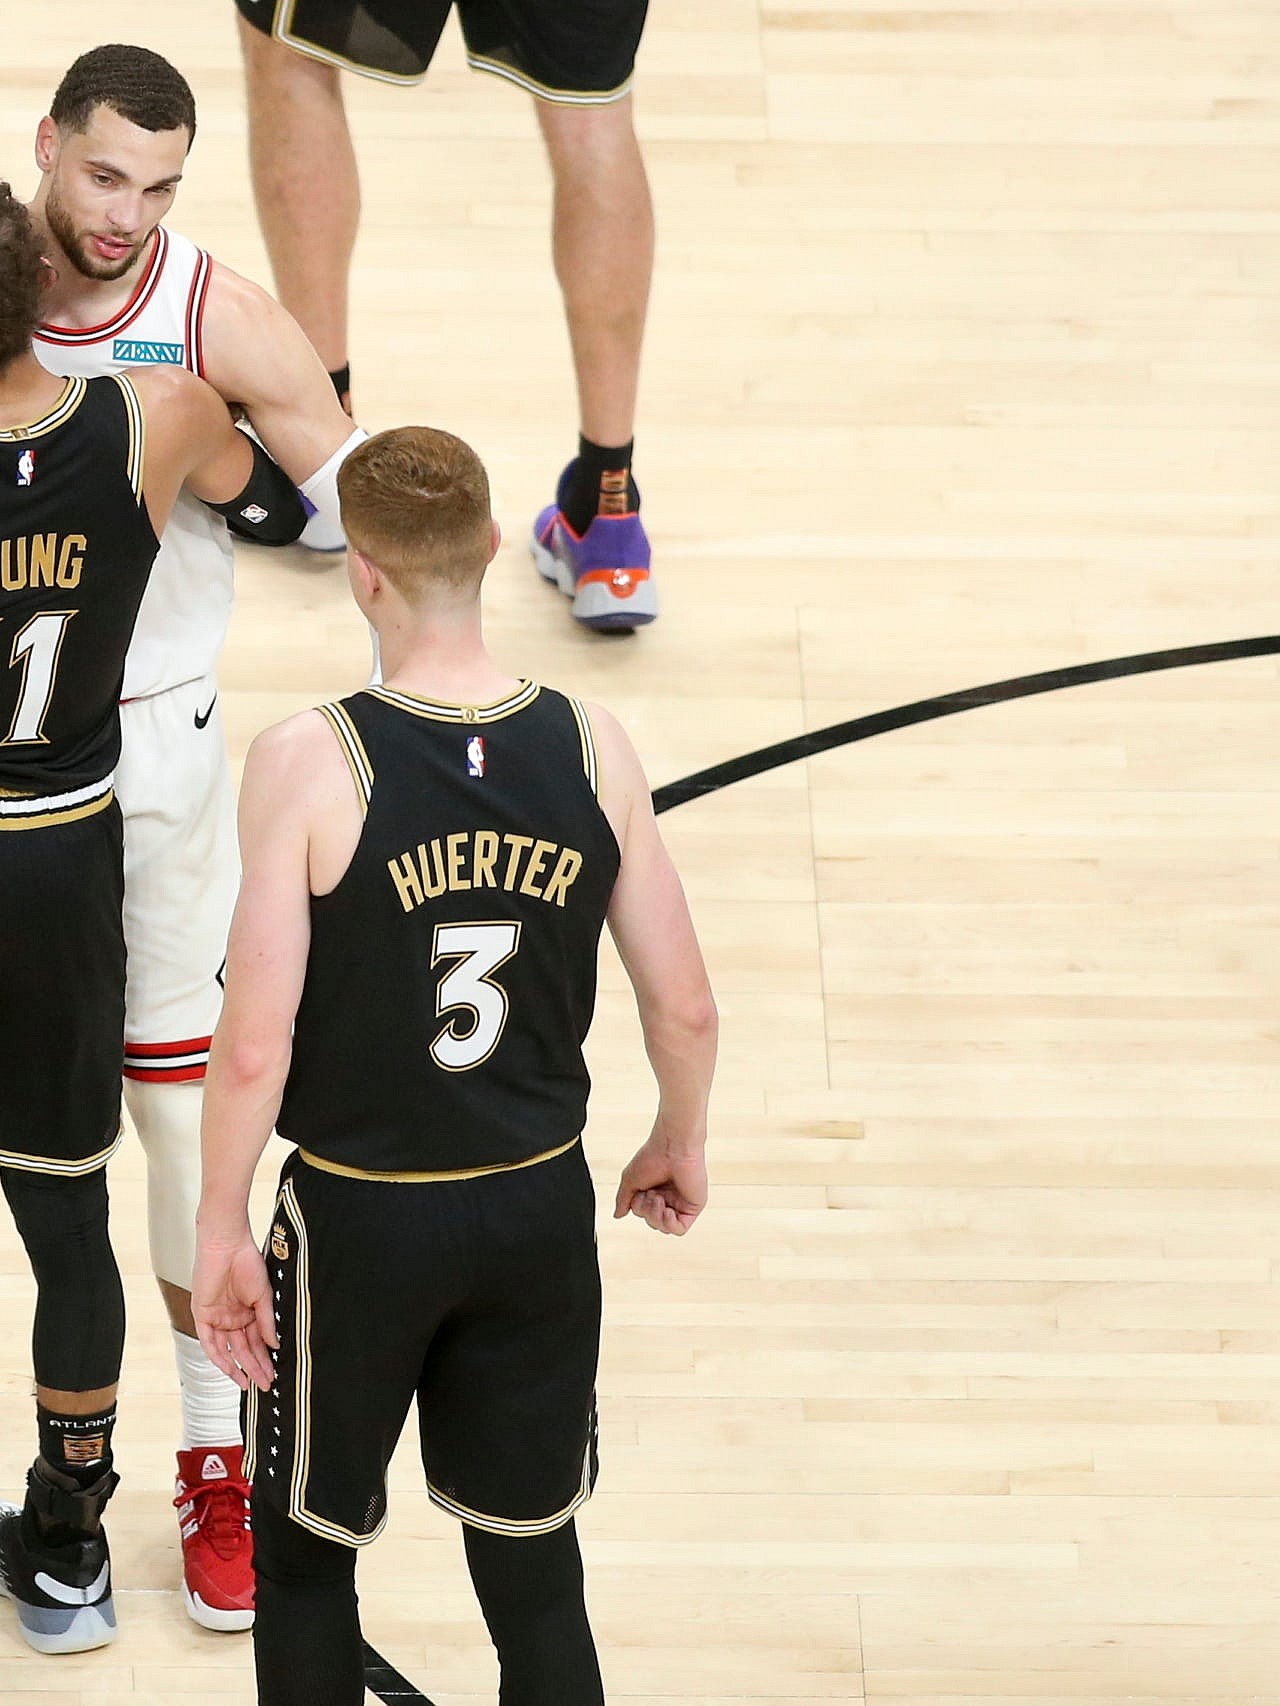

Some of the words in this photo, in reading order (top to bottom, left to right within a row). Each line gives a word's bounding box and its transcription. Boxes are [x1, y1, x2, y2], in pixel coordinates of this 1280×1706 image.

[115, 342, 182, 362] ZENNI
[386, 830, 584, 913] HUERTER
[428, 920, 523, 1074] 3
[49, 1413, 117, 1429] ATLANT
